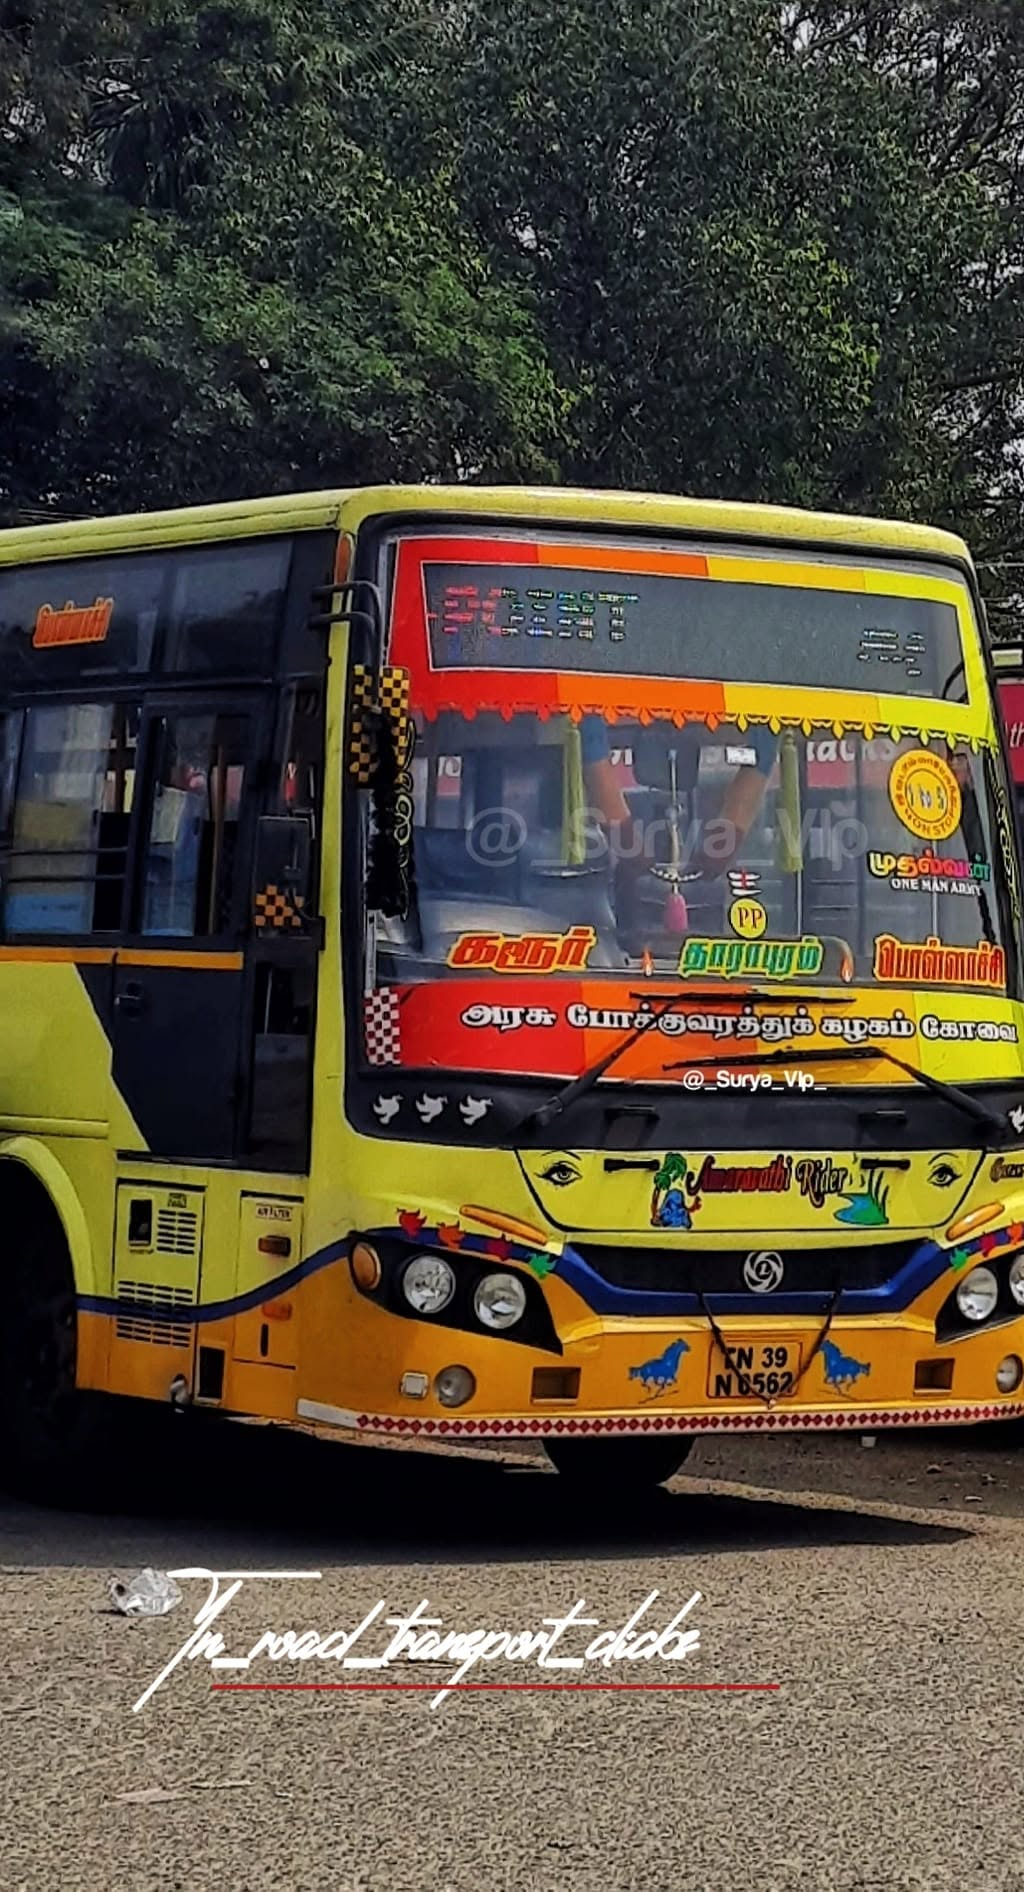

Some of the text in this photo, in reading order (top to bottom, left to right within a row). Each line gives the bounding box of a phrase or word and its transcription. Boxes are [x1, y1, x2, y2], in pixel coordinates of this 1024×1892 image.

[891, 878, 981, 897] ONE MAN ARMY
[737, 907, 763, 929] PP
[449, 927, 596, 973] கரூர்
[679, 935, 823, 979] தாராபுரம்
[874, 934, 1005, 988] பொள்ளாச்சி
[461, 1003, 557, 1032] அரசு
[821, 1011, 914, 1043] கழகம்
[920, 1015, 1018, 1042] கோவை
[796, 1158, 849, 1208] Rider
[724, 1347, 788, 1369] TN 39
[715, 1374, 732, 1396] N
